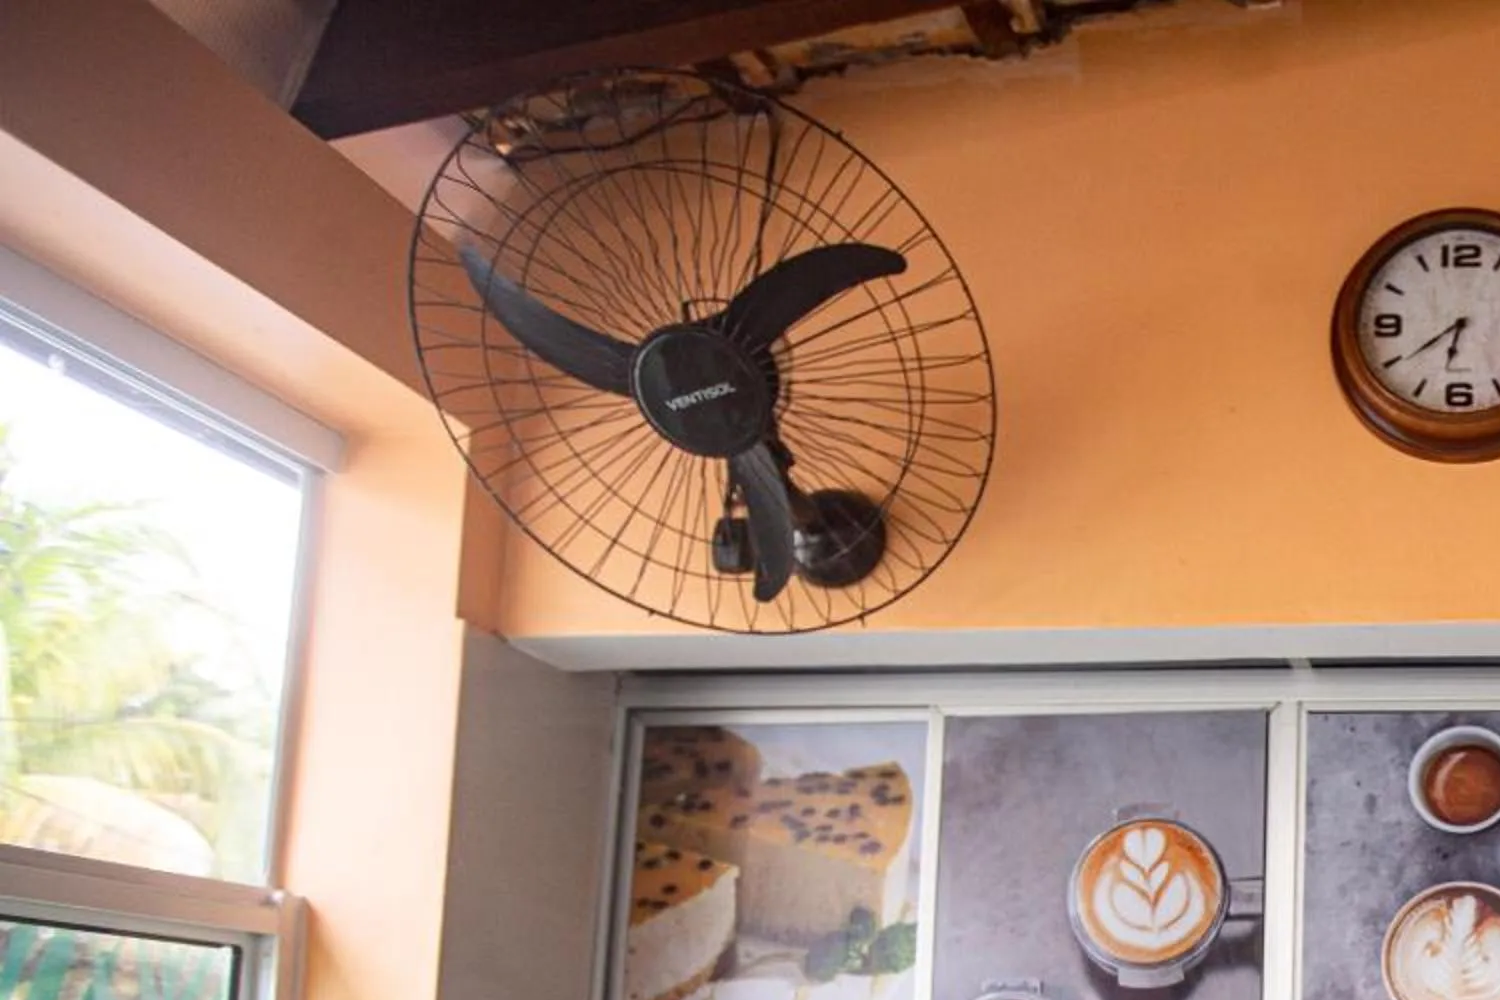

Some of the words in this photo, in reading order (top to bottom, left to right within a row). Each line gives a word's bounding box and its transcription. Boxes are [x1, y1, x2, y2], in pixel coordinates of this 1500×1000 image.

[1440, 245, 1482, 268] 12
[1374, 314, 1402, 338] 9
[665, 382, 737, 412] VENTISOL
[1445, 383, 1473, 407] 6
